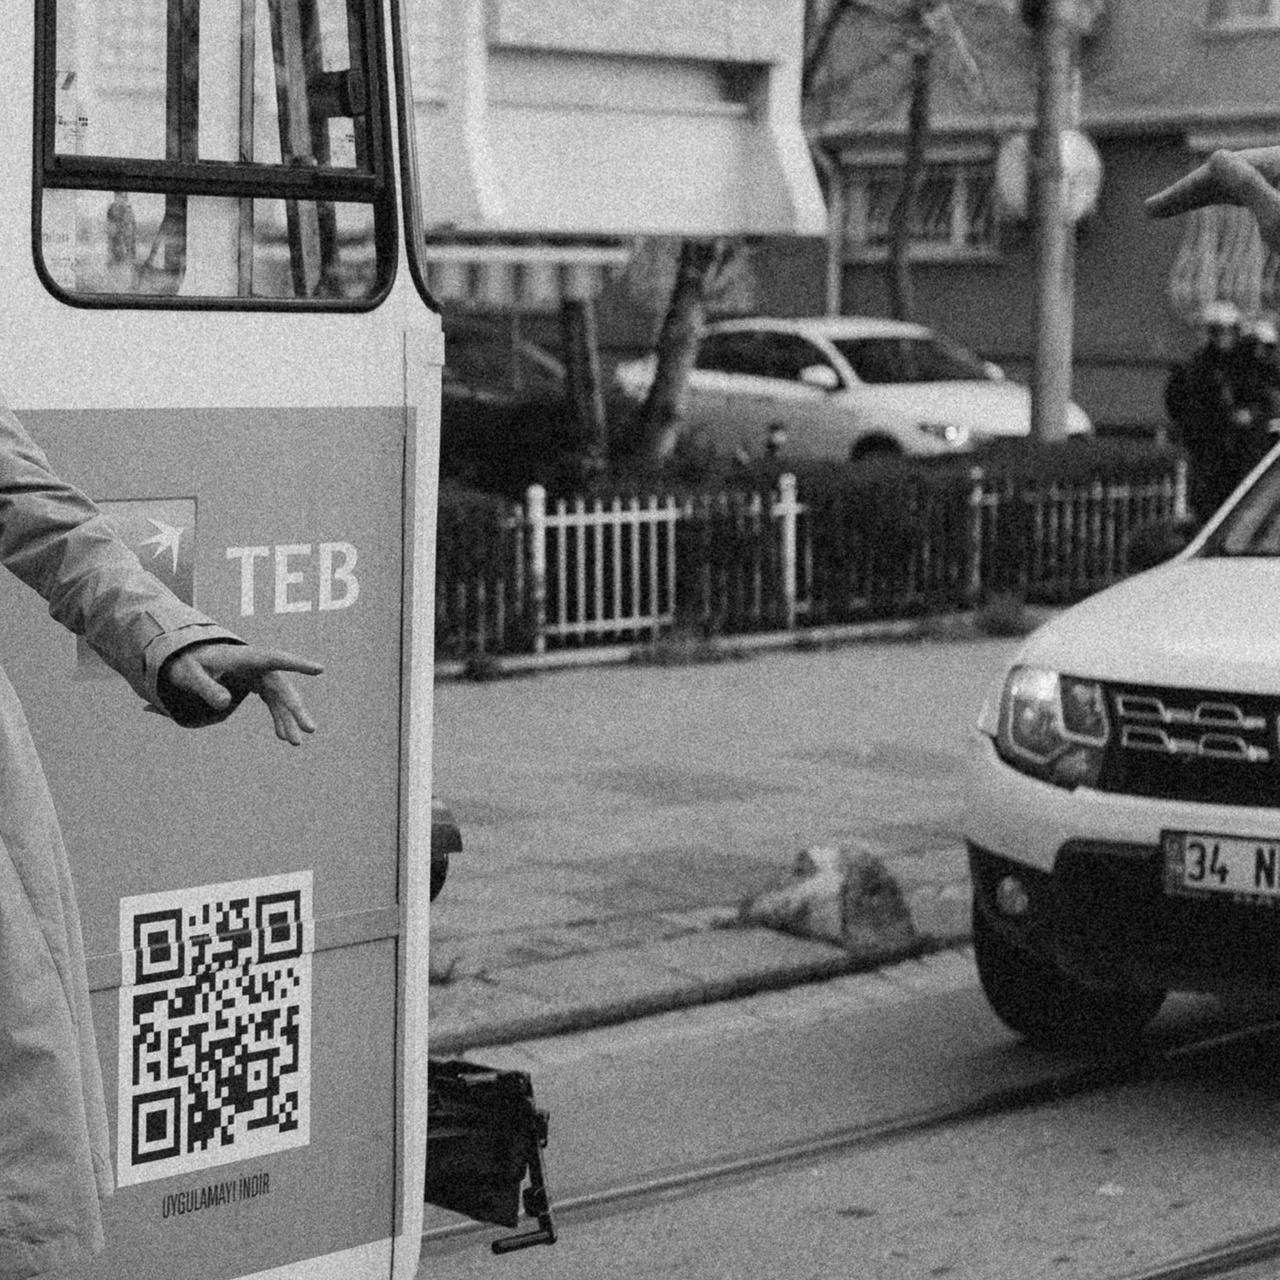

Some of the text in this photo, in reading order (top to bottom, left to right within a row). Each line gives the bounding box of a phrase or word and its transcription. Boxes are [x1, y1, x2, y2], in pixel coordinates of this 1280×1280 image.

[226, 541, 360, 616] TEB
[1187, 842, 1280, 889] 34 N
[162, 1179, 237, 1219] UYGULAMAYI
